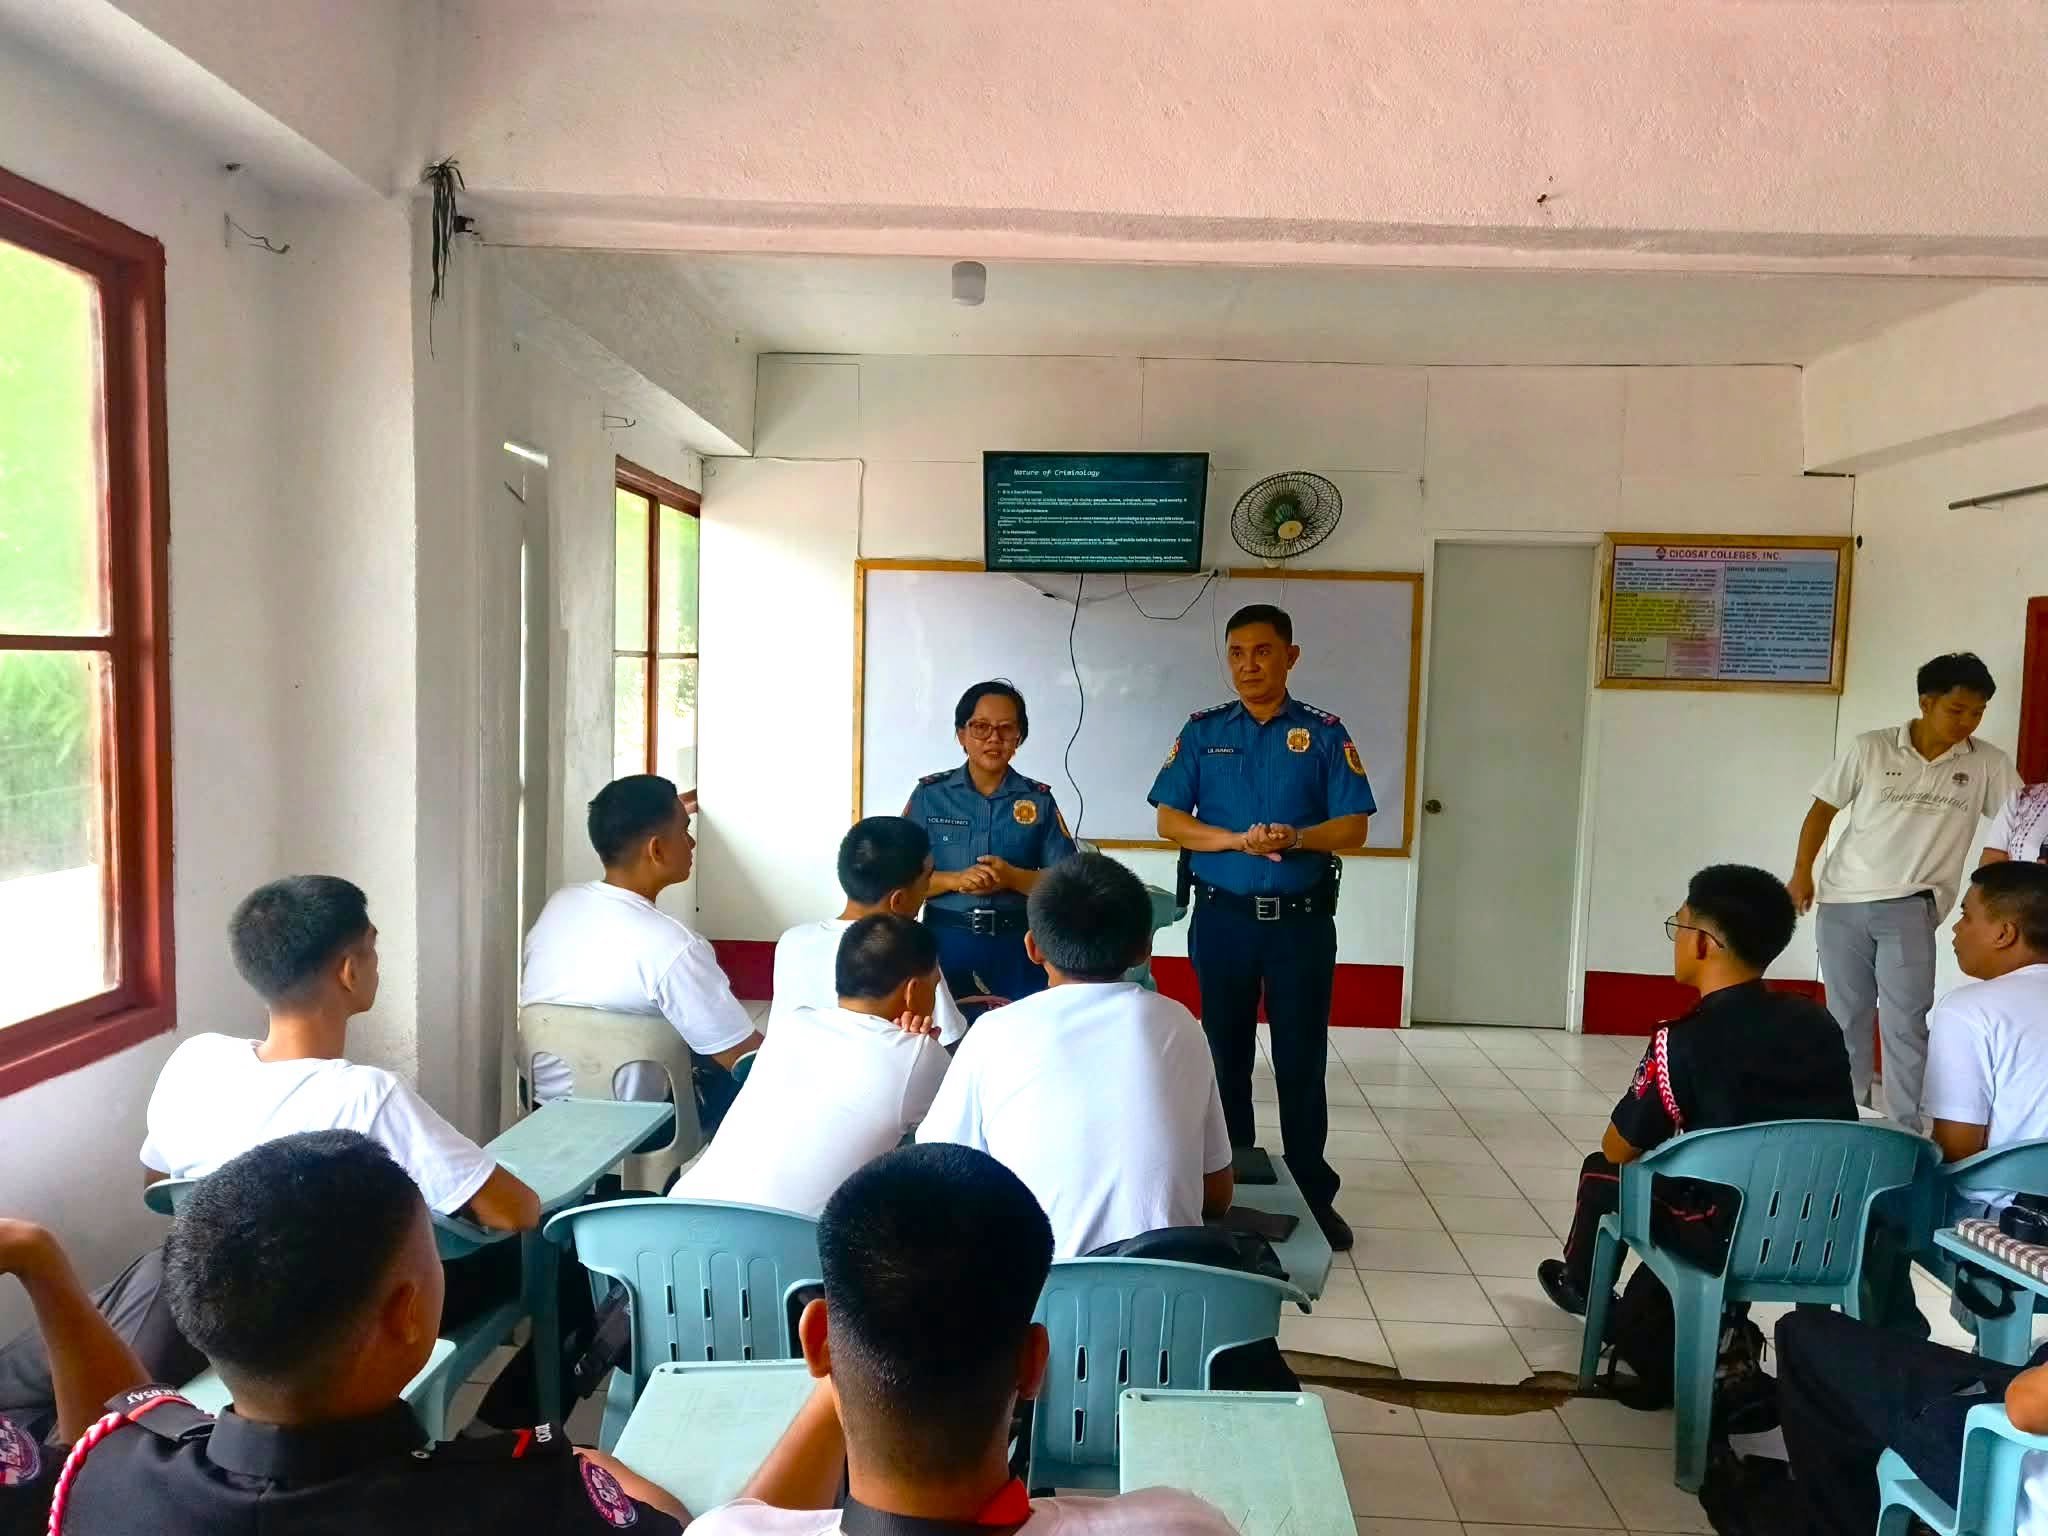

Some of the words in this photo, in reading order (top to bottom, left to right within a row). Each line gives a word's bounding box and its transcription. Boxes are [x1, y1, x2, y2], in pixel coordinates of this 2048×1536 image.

[1042, 469, 1052, 477] of
[1054, 469, 1100, 477] Criminology
[1669, 550, 1708, 559] CICOSAT
[1710, 550, 1760, 561] COLLEGES,
[1763, 551, 1782, 560] INC.
